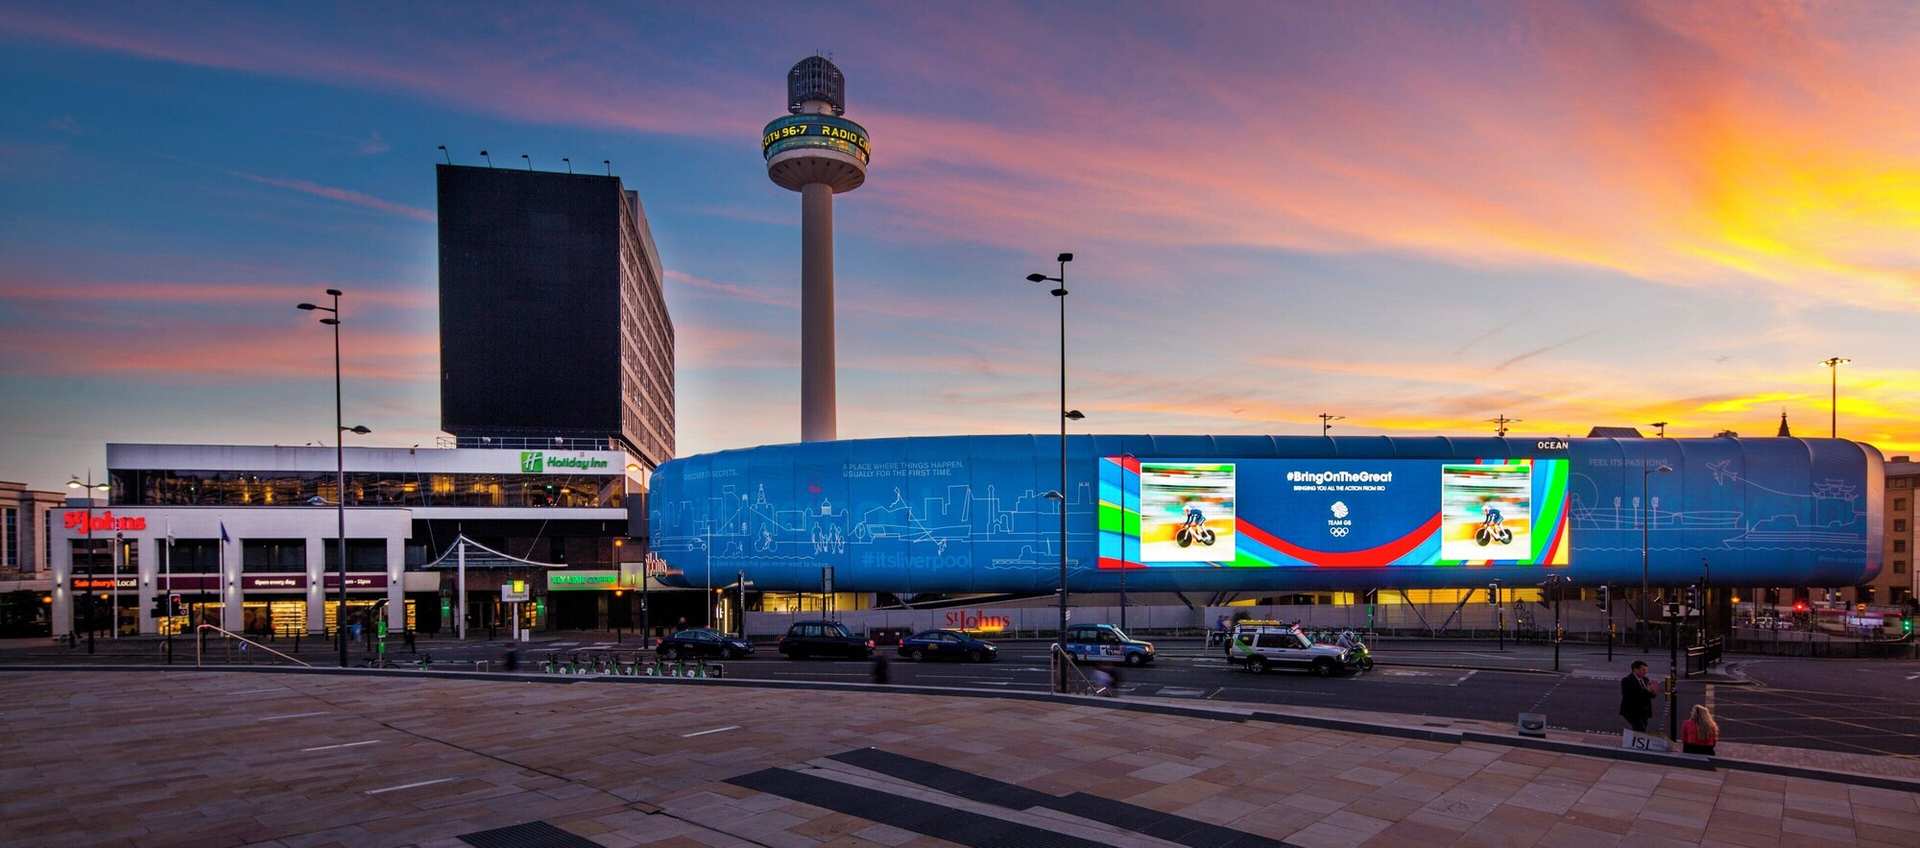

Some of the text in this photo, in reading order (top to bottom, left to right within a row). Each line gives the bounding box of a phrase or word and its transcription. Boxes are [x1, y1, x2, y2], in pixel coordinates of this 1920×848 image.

[822, 126, 857, 143] RADIO
[1537, 441, 1569, 450] OCEAN
[547, 456, 608, 470] Holiday Inn
[849, 463, 872, 471] PLACE
[874, 462, 900, 470] WHERE
[901, 462, 929, 470] THINGS
[908, 469, 931, 477] FIRST
[1286, 471, 1393, 484] #BringOnTheGreat
[117, 579, 137, 587] Local
